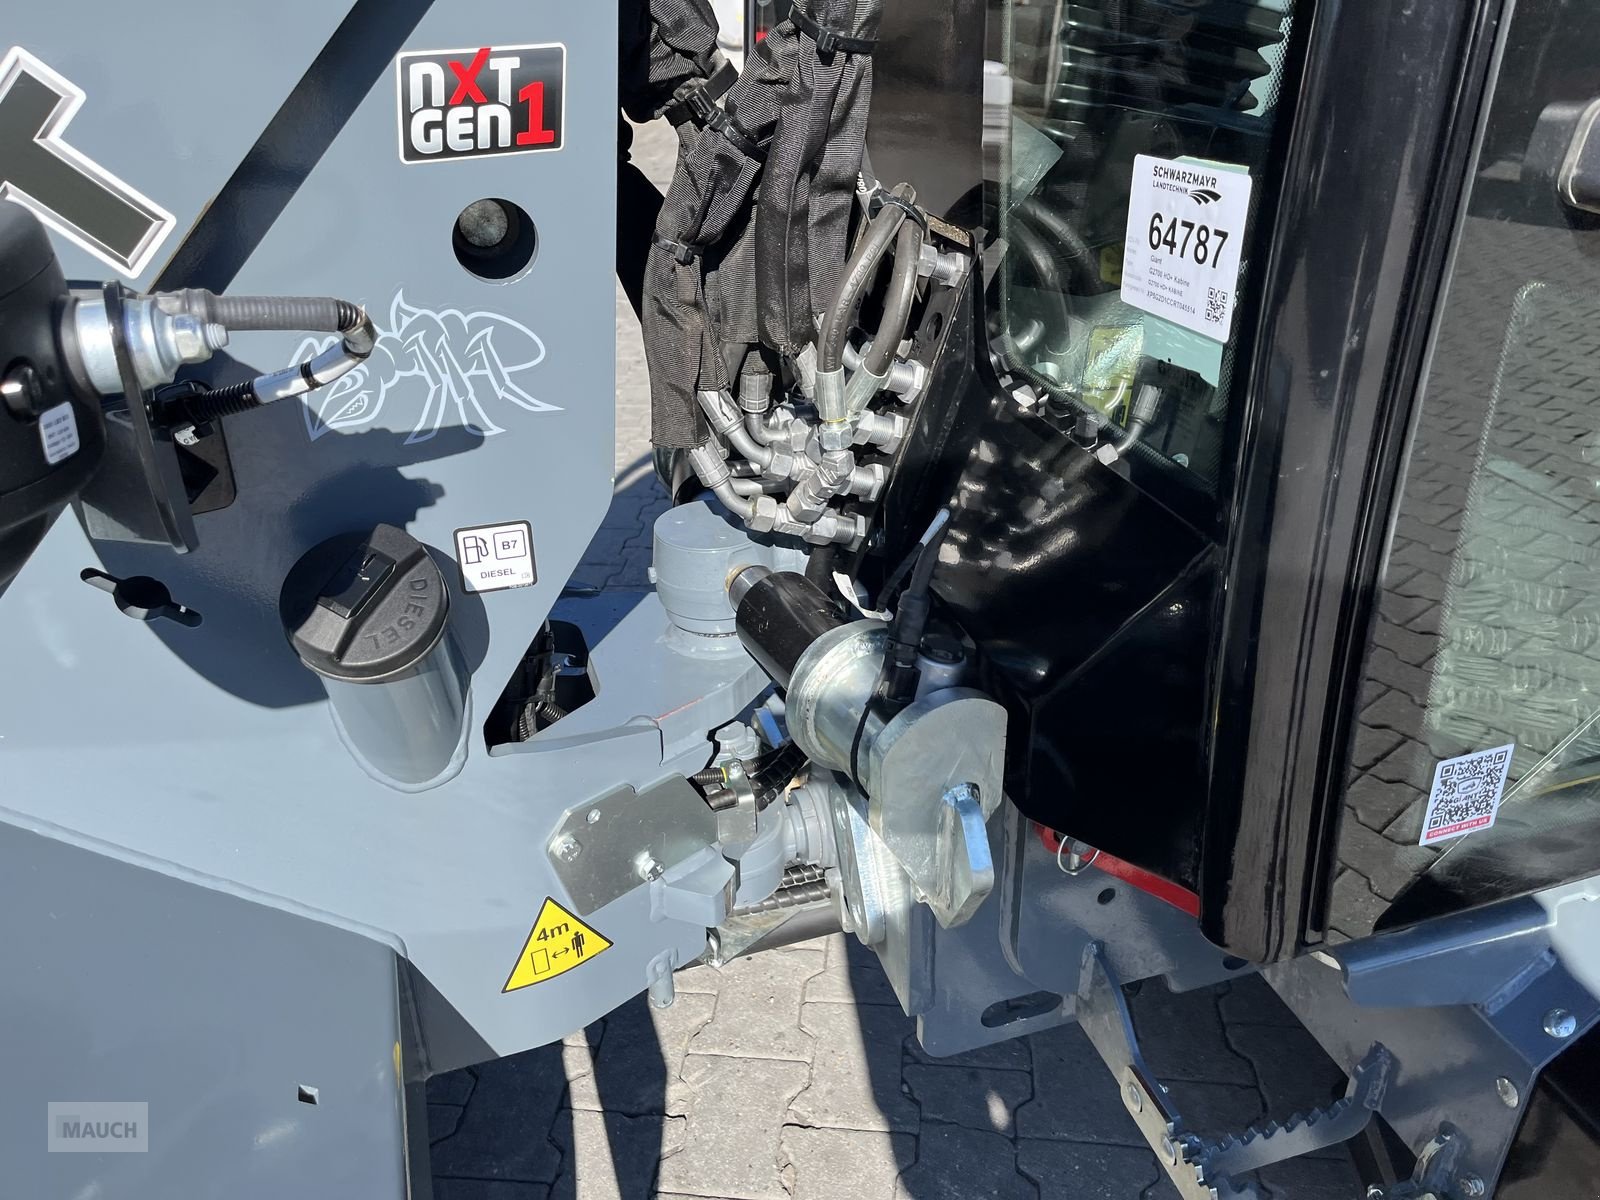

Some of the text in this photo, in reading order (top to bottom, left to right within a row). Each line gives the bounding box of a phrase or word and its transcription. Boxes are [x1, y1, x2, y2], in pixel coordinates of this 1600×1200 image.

[517, 81, 554, 145] 1
[1153, 165, 1217, 189] SCHWARZMAYR
[1152, 180, 1189, 195] LANDTECHNIK
[1149, 212, 1228, 269] 64787
[1150, 254, 1162, 265] Giant
[1174, 275, 1190, 287] Kabine
[502, 540, 517, 550] B7
[480, 568, 516, 579] DIESEL
[363, 577, 427, 649] DIESEL
[1453, 792, 1478, 804] GIANT
[1429, 825, 1460, 837] CONNECT
[1461, 820, 1478, 829] WITH
[1478, 817, 1488, 825] US
[537, 922, 569, 941] 4m
